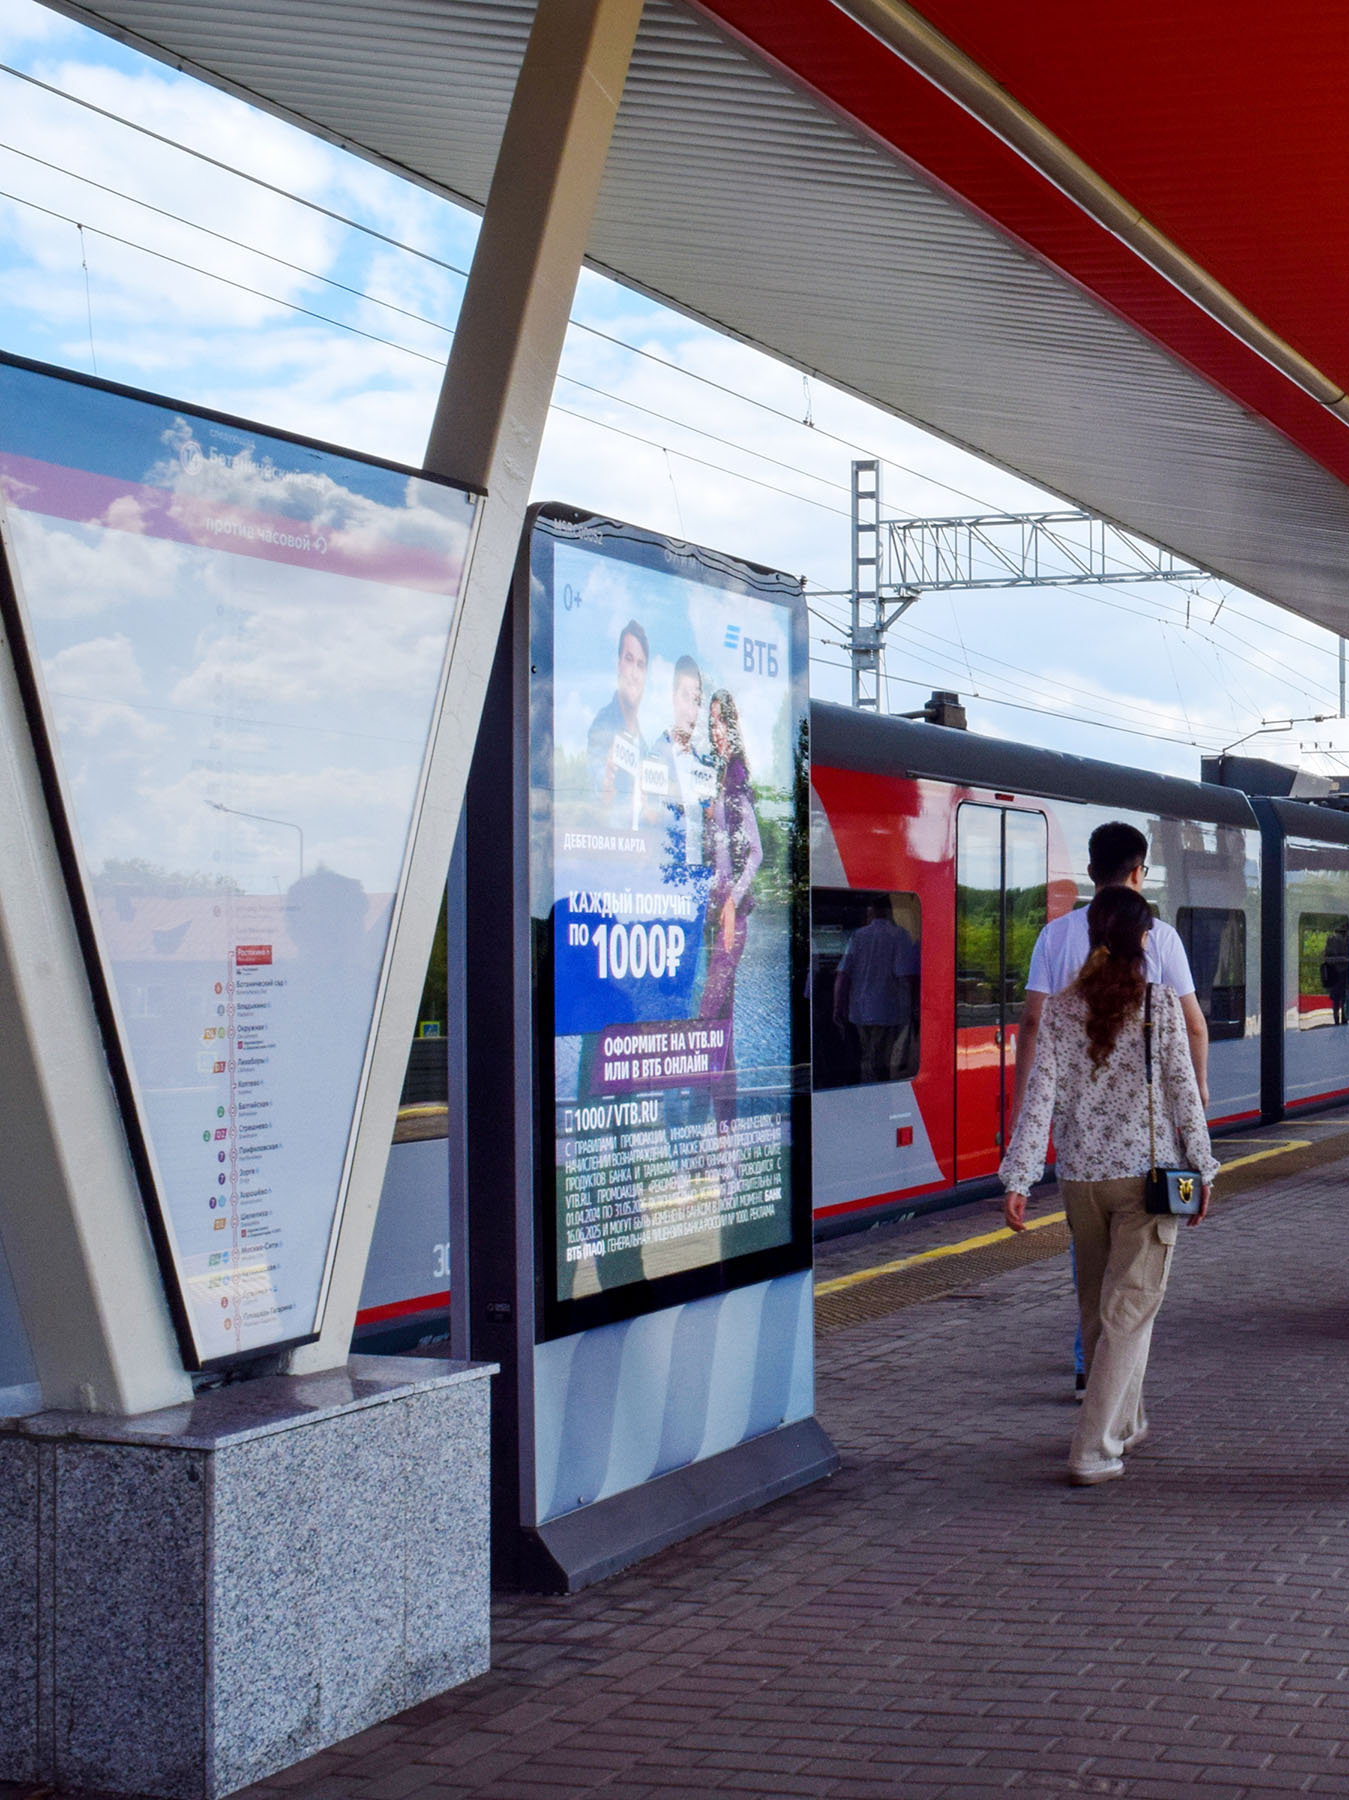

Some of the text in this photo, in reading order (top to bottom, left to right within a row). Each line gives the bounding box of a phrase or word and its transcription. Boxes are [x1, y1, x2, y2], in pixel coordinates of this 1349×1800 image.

[206, 517, 311, 551] против часовой
[563, 583, 583, 611] 0+
[743, 637, 779, 678] ВТБ
[563, 832, 647, 854] ДЕБЕТОВАЯ КАРТА
[569, 888, 693, 918] КАЖДЫЙ ПОЛУЧИТ
[569, 924, 686, 980] ПО 1000₽
[604, 1029, 724, 1057] ОФОРМИТЕ НА VTB.RU
[604, 1051, 709, 1082] ИЛИ В ВТБ ОНЛАЙН
[575, 1100, 659, 1130] 1000/VTB.RU
[565, 1142, 571, 1157] С
[565, 1172, 606, 1192] ПРОДУКТОВ
[608, 1167, 632, 1184] БАНКА
[634, 1166, 641, 1180] И
[602, 1204, 614, 1219] ПО
[602, 1222, 609, 1237] И
[610, 1217, 632, 1235] МОГУТ
[764, 1187, 782, 1202] БАНК
[566, 1244, 583, 1263] ВТБ
[607, 1230, 651, 1253] ГЕНЕРАЛЬНАЯ
